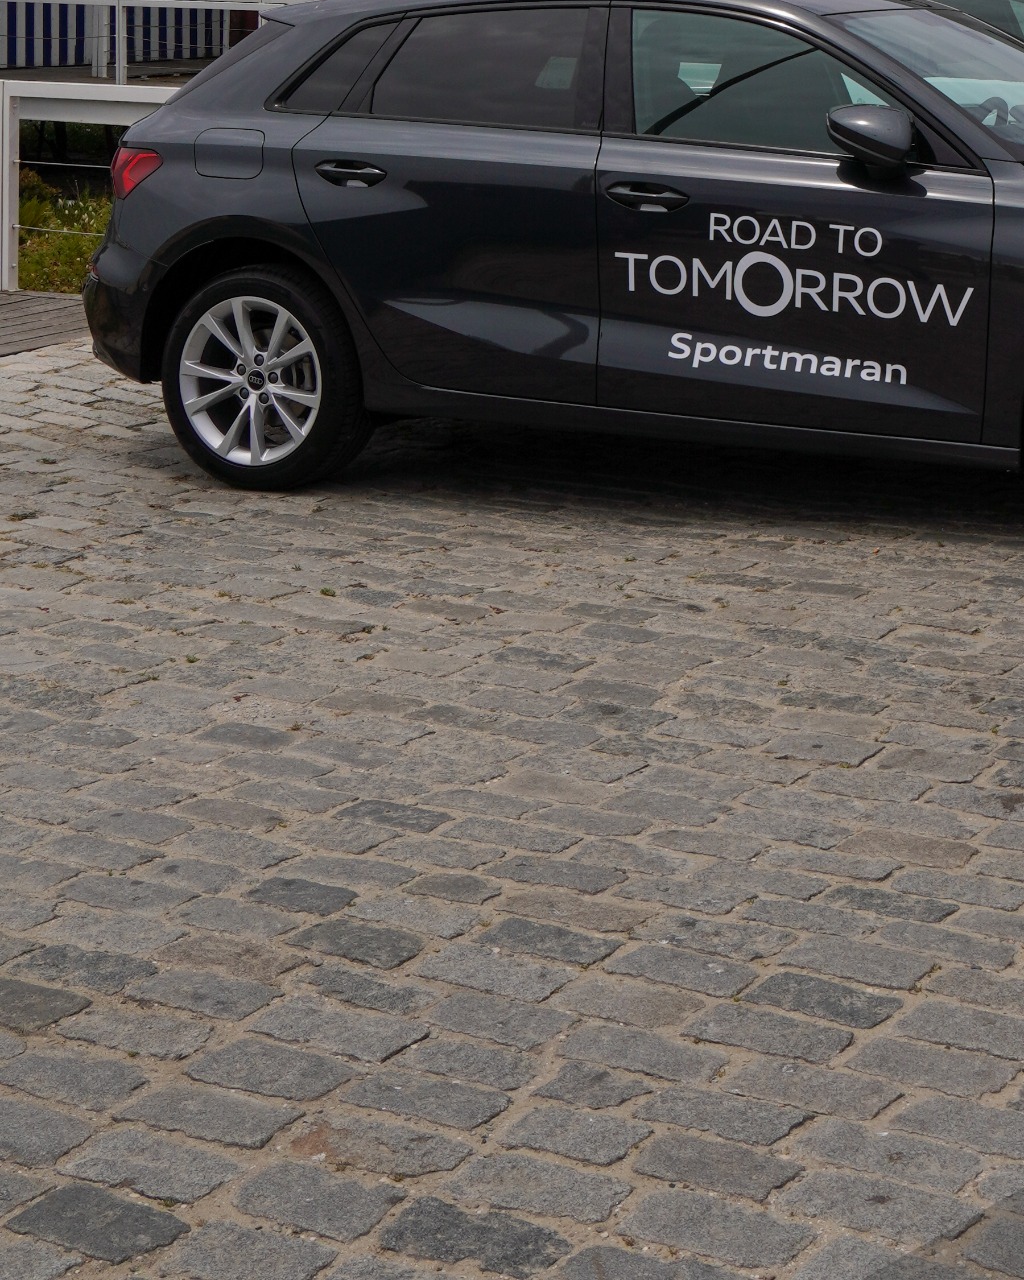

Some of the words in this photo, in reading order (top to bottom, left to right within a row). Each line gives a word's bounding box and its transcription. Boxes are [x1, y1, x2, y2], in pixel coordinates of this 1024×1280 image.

[708, 212, 817, 250] ROAD
[829, 224, 883, 257] TO
[614, 251, 974, 327] TOMORROW
[667, 332, 908, 385] Sportmaran
